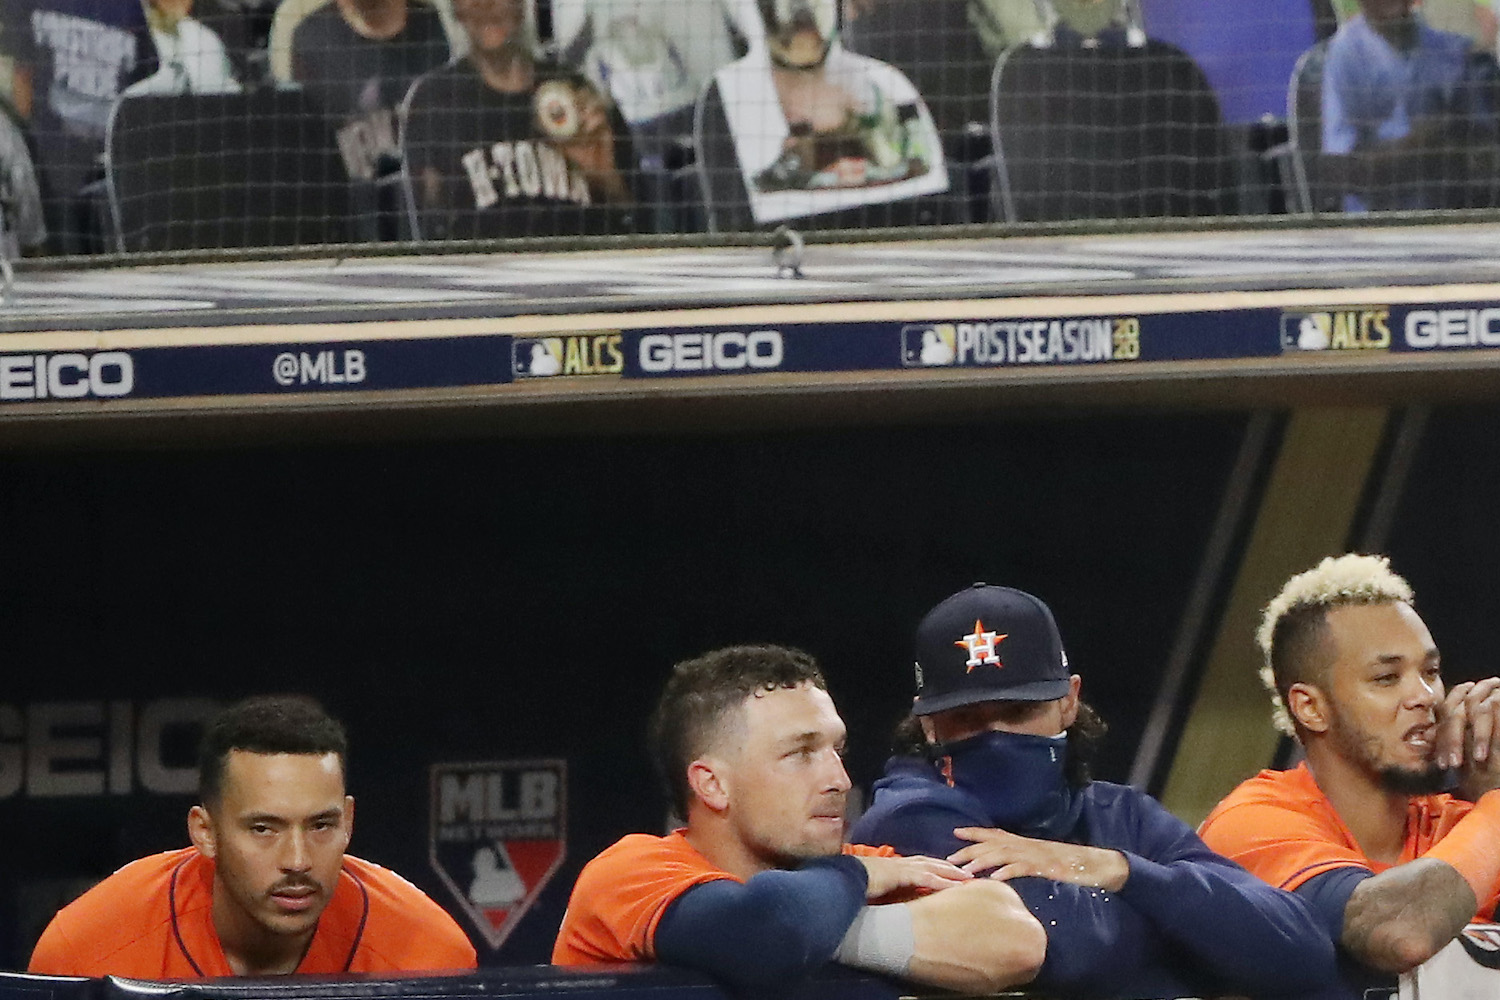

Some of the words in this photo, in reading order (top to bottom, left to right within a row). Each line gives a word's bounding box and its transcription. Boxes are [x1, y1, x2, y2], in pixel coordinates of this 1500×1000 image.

[639, 330, 784, 373] GEICO
[956, 319, 1113, 364] POSTSEASON
[1331, 310, 1391, 350] ALCS
[0, 351, 134, 399] EICO
[273, 350, 366, 386] @MLB
[564, 333, 624, 375] ALCS
[0, 696, 212, 800] EIC
[440, 771, 558, 823] MLB
